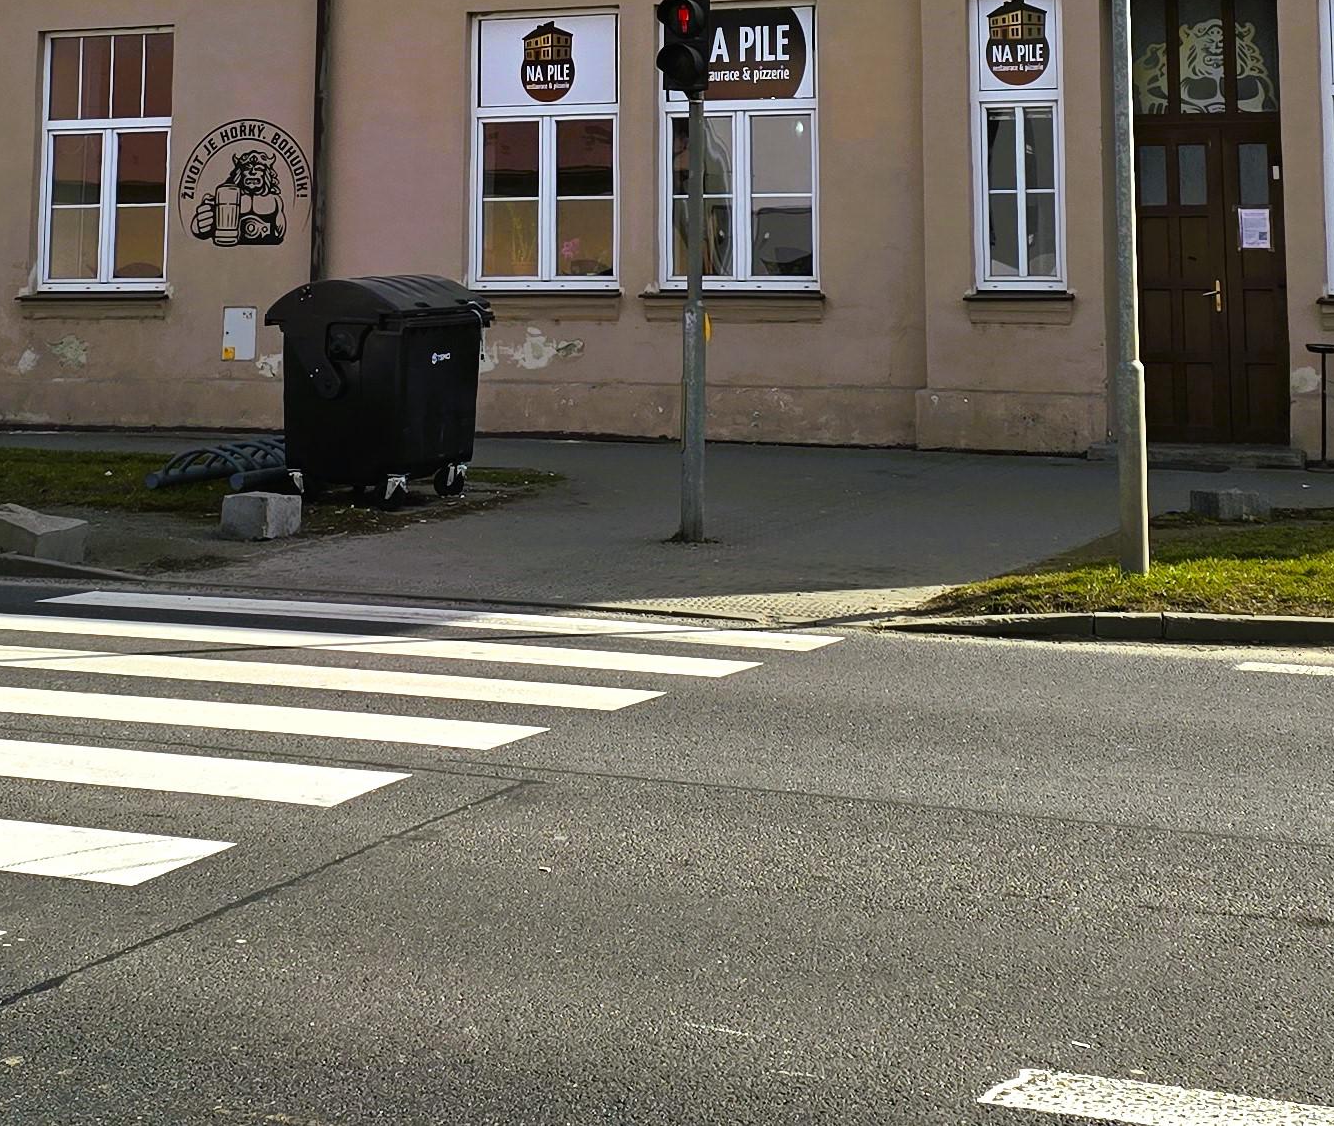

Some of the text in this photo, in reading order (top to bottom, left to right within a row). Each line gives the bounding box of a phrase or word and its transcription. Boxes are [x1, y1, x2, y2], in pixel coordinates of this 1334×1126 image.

[709, 24, 790, 63] A PILE
[992, 43, 1044, 63] NA PILE
[526, 64, 570, 82] NA PILE
[708, 64, 790, 84] aurace & pizzerie
[181, 122, 310, 200] ŽIVOT JE HOŘKÝ. BOHUDÍK!
